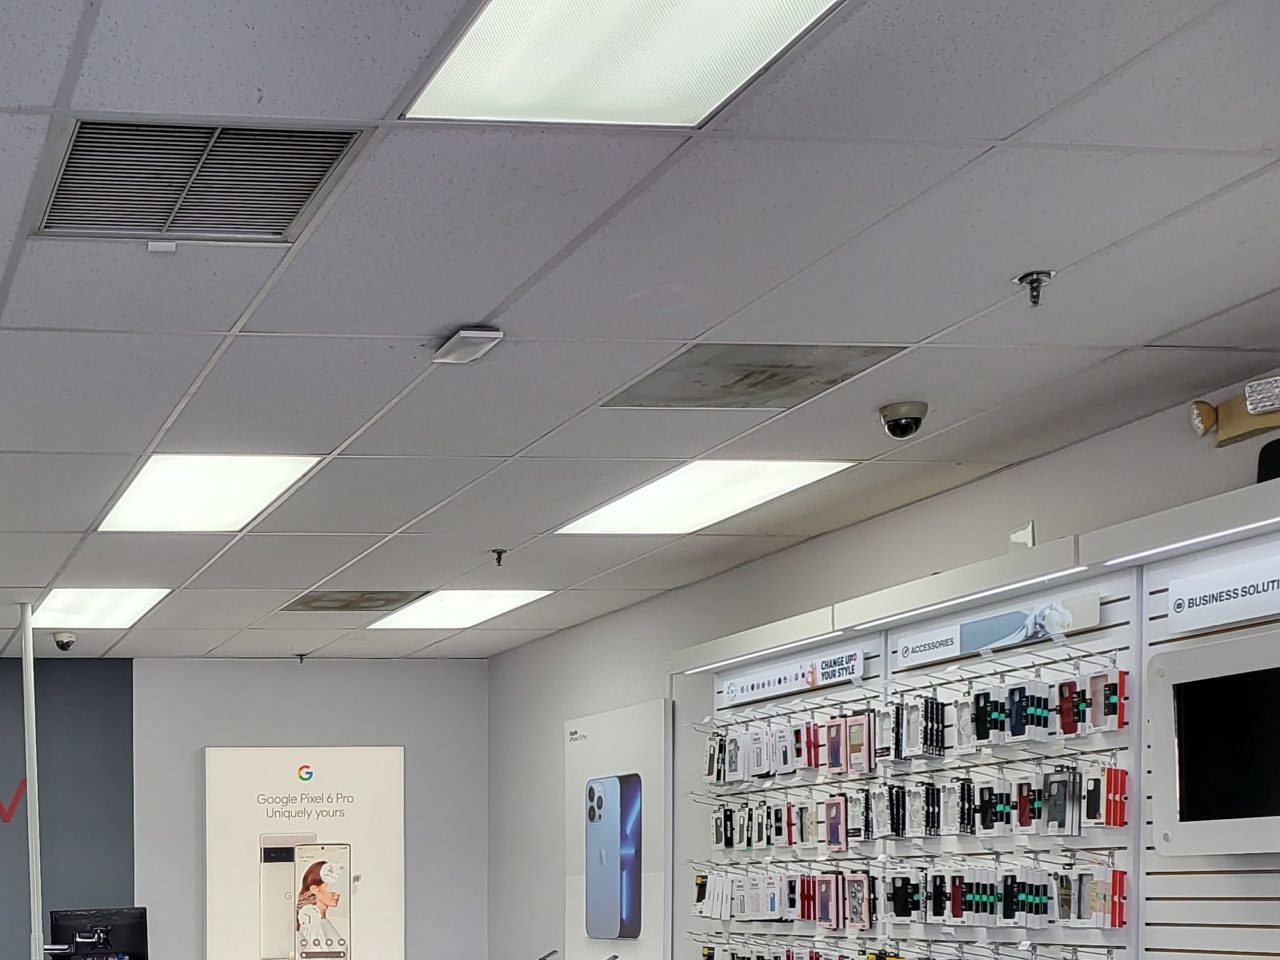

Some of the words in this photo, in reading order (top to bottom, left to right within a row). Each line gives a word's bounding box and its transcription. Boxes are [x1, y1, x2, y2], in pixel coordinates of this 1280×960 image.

[1188, 588, 1239, 609] BUSINESS
[910, 637, 955, 655] ACCESSORIES
[820, 656, 844, 671] CHANGE
[820, 669, 838, 681] YOUR
[837, 664, 855, 679] STYLE
[297, 764, 313, 781] G
[256, 793, 298, 807] Google
[300, 792, 324, 804] Pixel
[326, 793, 334, 804] 6
[336, 792, 354, 804] Pro
[266, 807, 312, 820] Uniquely
[315, 809, 345, 820] yours
